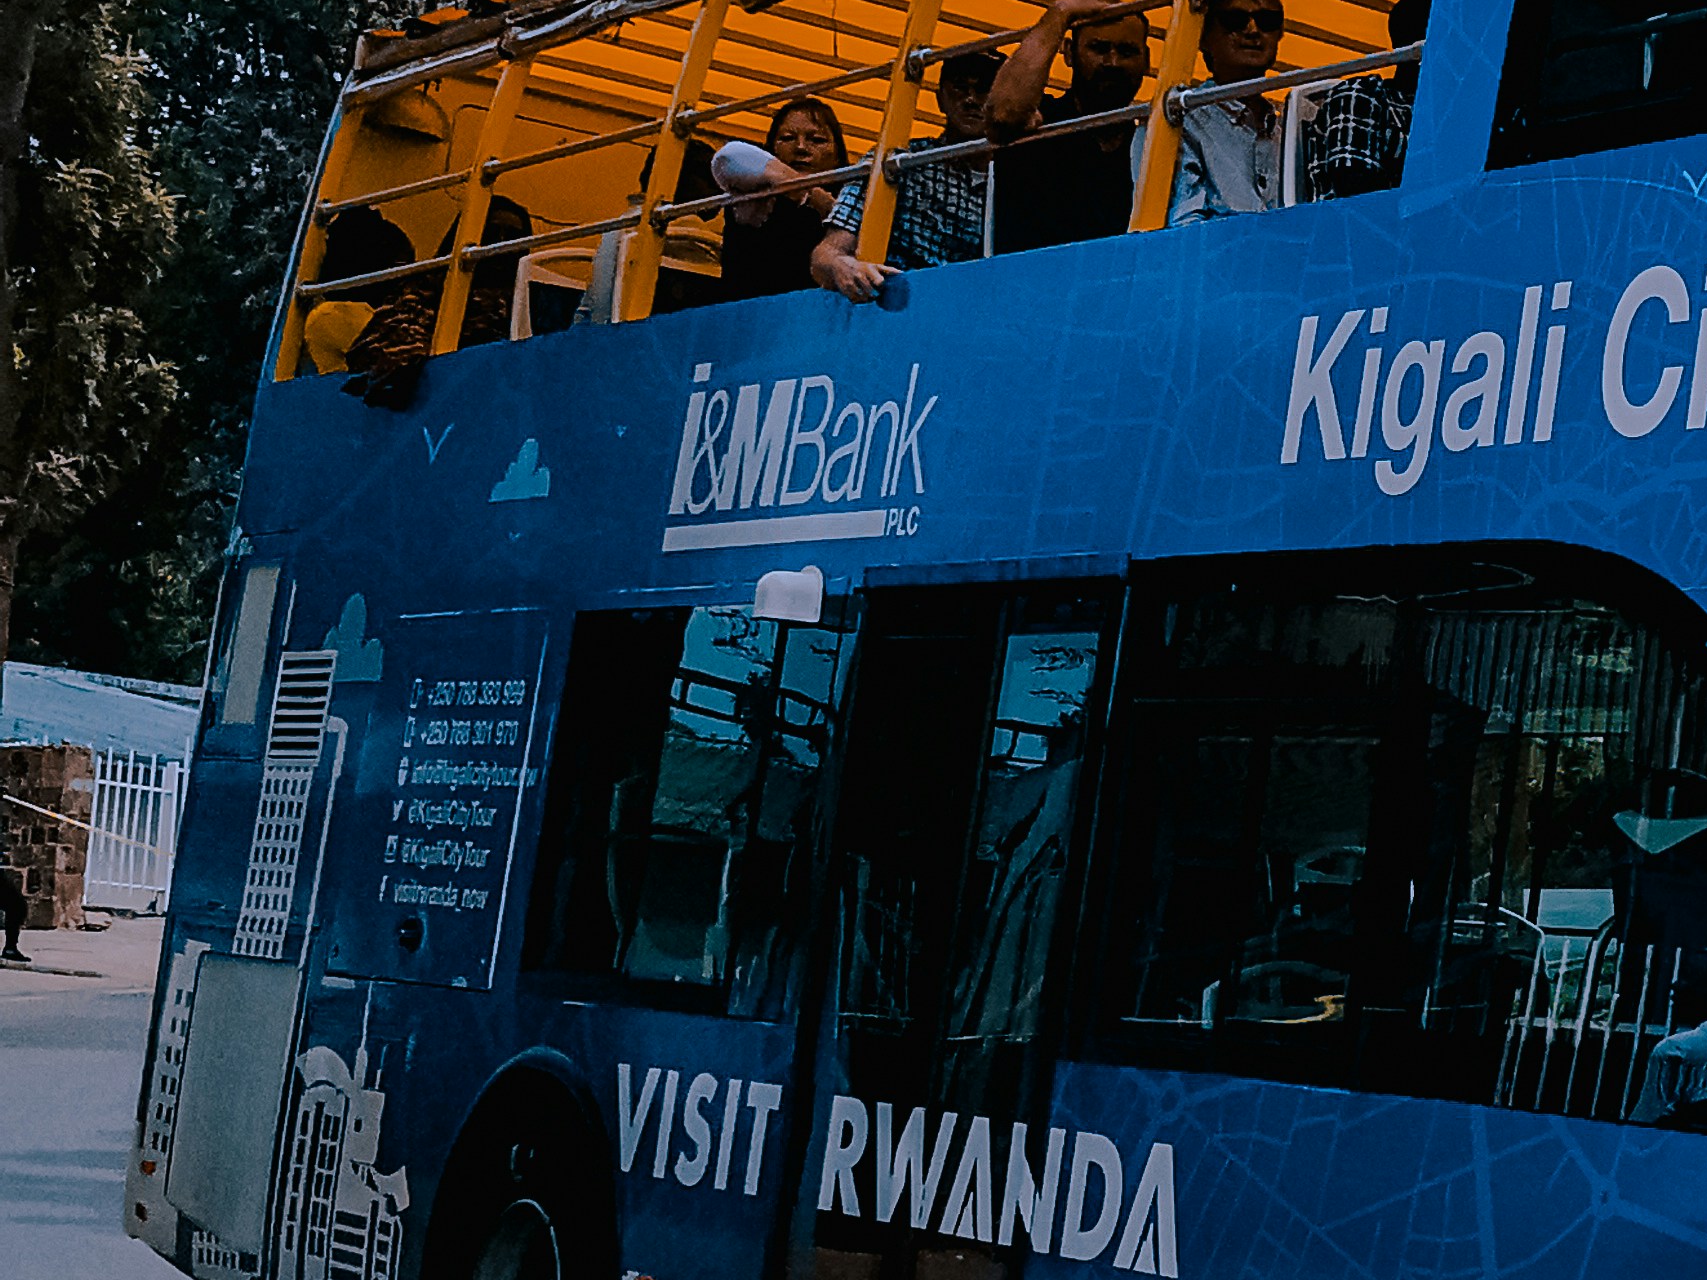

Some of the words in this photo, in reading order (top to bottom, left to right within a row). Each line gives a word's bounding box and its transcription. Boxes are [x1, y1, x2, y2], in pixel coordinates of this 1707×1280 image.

[1279, 280, 1573, 496] Kigali
[885, 505, 921, 537] PLC
[493, 720, 520, 746] 970
[616, 1062, 783, 1196] VISIT
[816, 1094, 1179, 1279] RWANDA
